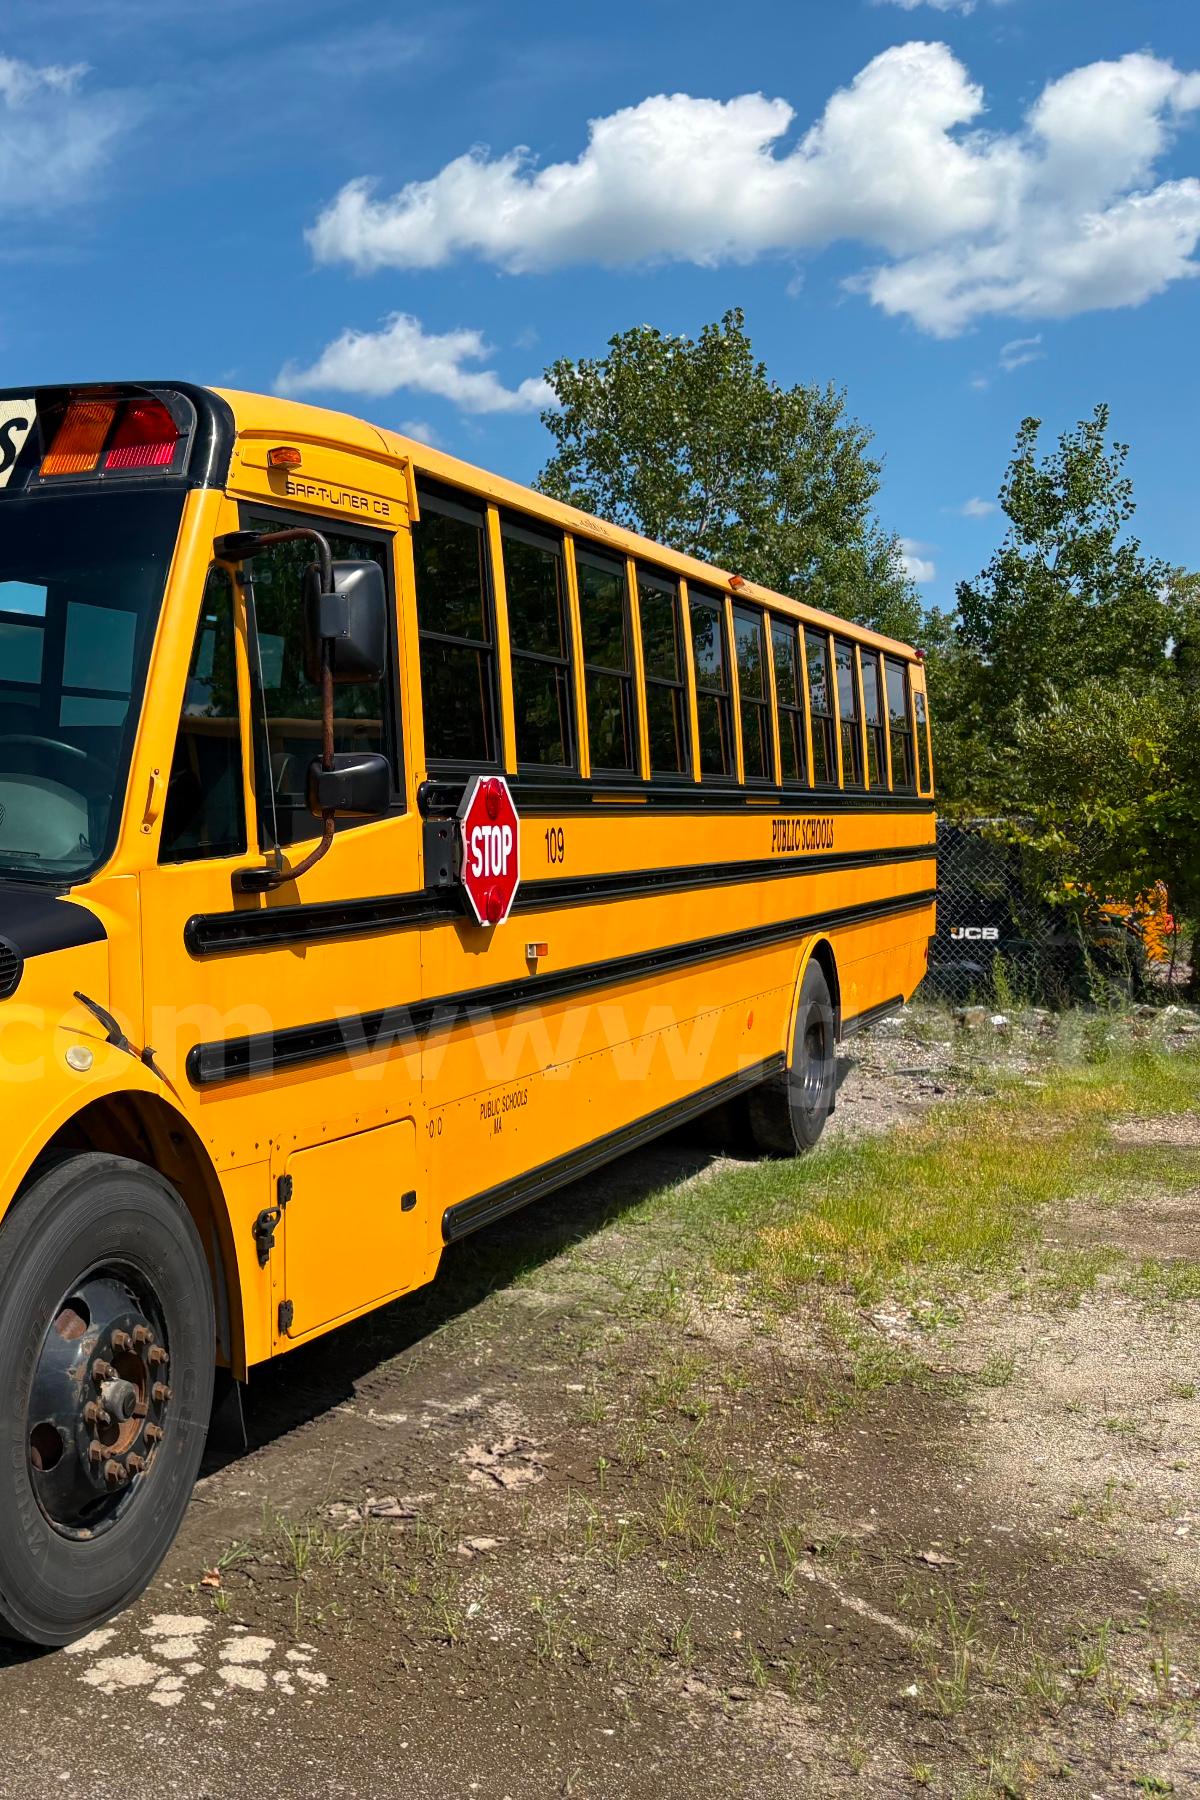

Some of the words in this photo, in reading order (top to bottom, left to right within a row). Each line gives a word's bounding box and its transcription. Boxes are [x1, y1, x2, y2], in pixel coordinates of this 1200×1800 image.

[373, 500, 390, 516] C2
[471, 824, 513, 878] STOP
[545, 827, 565, 863] 109
[771, 819, 800, 852] PUBLIC
[801, 818, 834, 850] SCHOOLS
[950, 927, 999, 940] JCB
[480, 1097, 501, 1120] PUBLIC
[502, 1088, 528, 1113] SCHOOLS
[493, 1115, 503, 1134] MA
